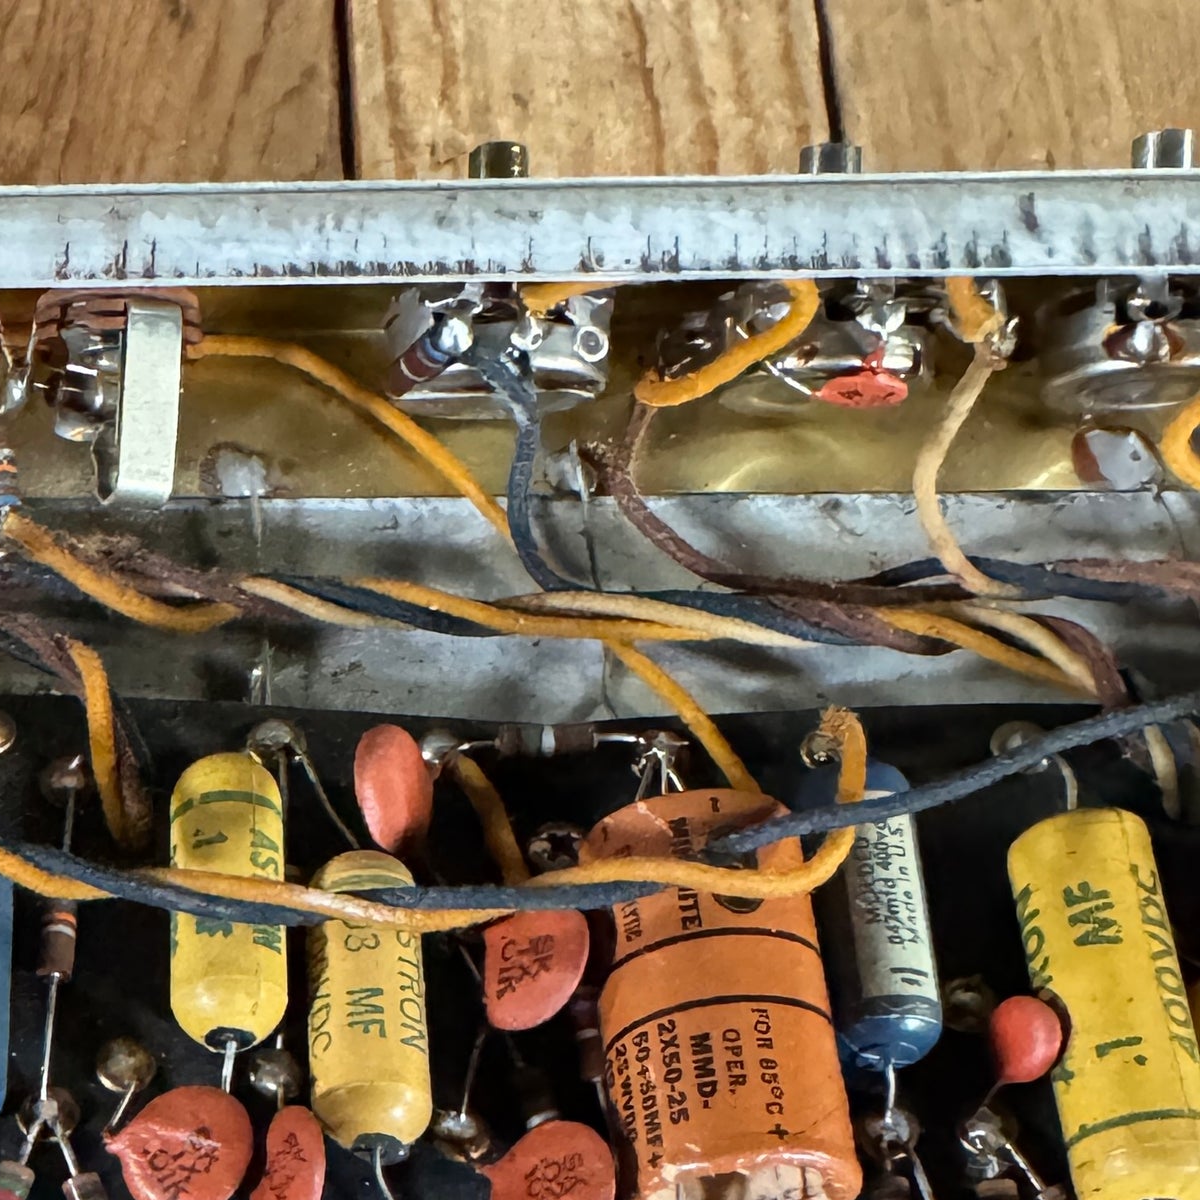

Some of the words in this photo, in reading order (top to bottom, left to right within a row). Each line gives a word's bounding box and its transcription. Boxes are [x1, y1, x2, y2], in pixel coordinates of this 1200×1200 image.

[1062, 880, 1124, 947] MF
[345, 987, 388, 1039] MF
[657, 1018, 690, 1126] 2X50-25
[689, 1031, 718, 1110] MMD-
[1094, 1035, 1149, 1067] .1
